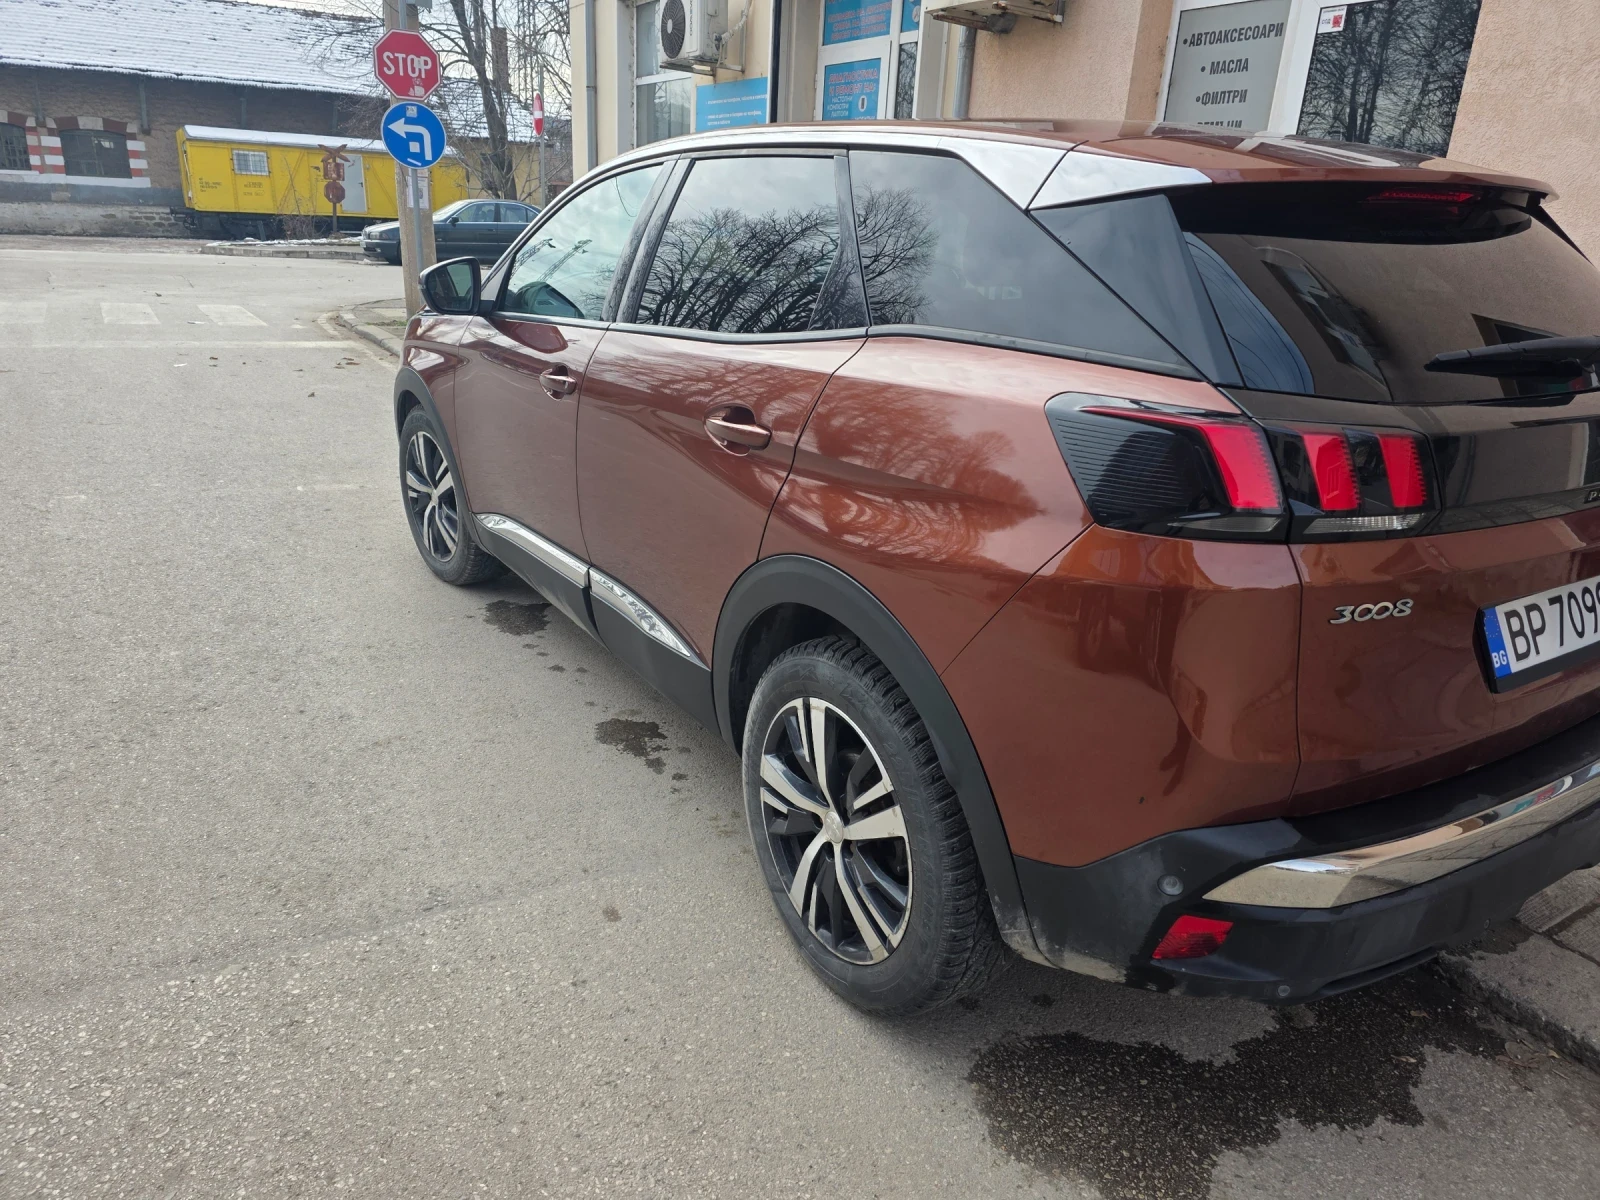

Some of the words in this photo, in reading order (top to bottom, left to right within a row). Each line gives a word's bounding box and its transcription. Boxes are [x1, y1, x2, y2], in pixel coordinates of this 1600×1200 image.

[1188, 22, 1284, 47] АВТОАКСЕСОАРИ
[383, 51, 432, 79] STOP
[1209, 57, 1249, 75] МАСЛА
[1201, 89, 1247, 106] ФИЛТРИ
[1329, 598, 1414, 624] 3008
[1491, 650, 1508, 669] BG
